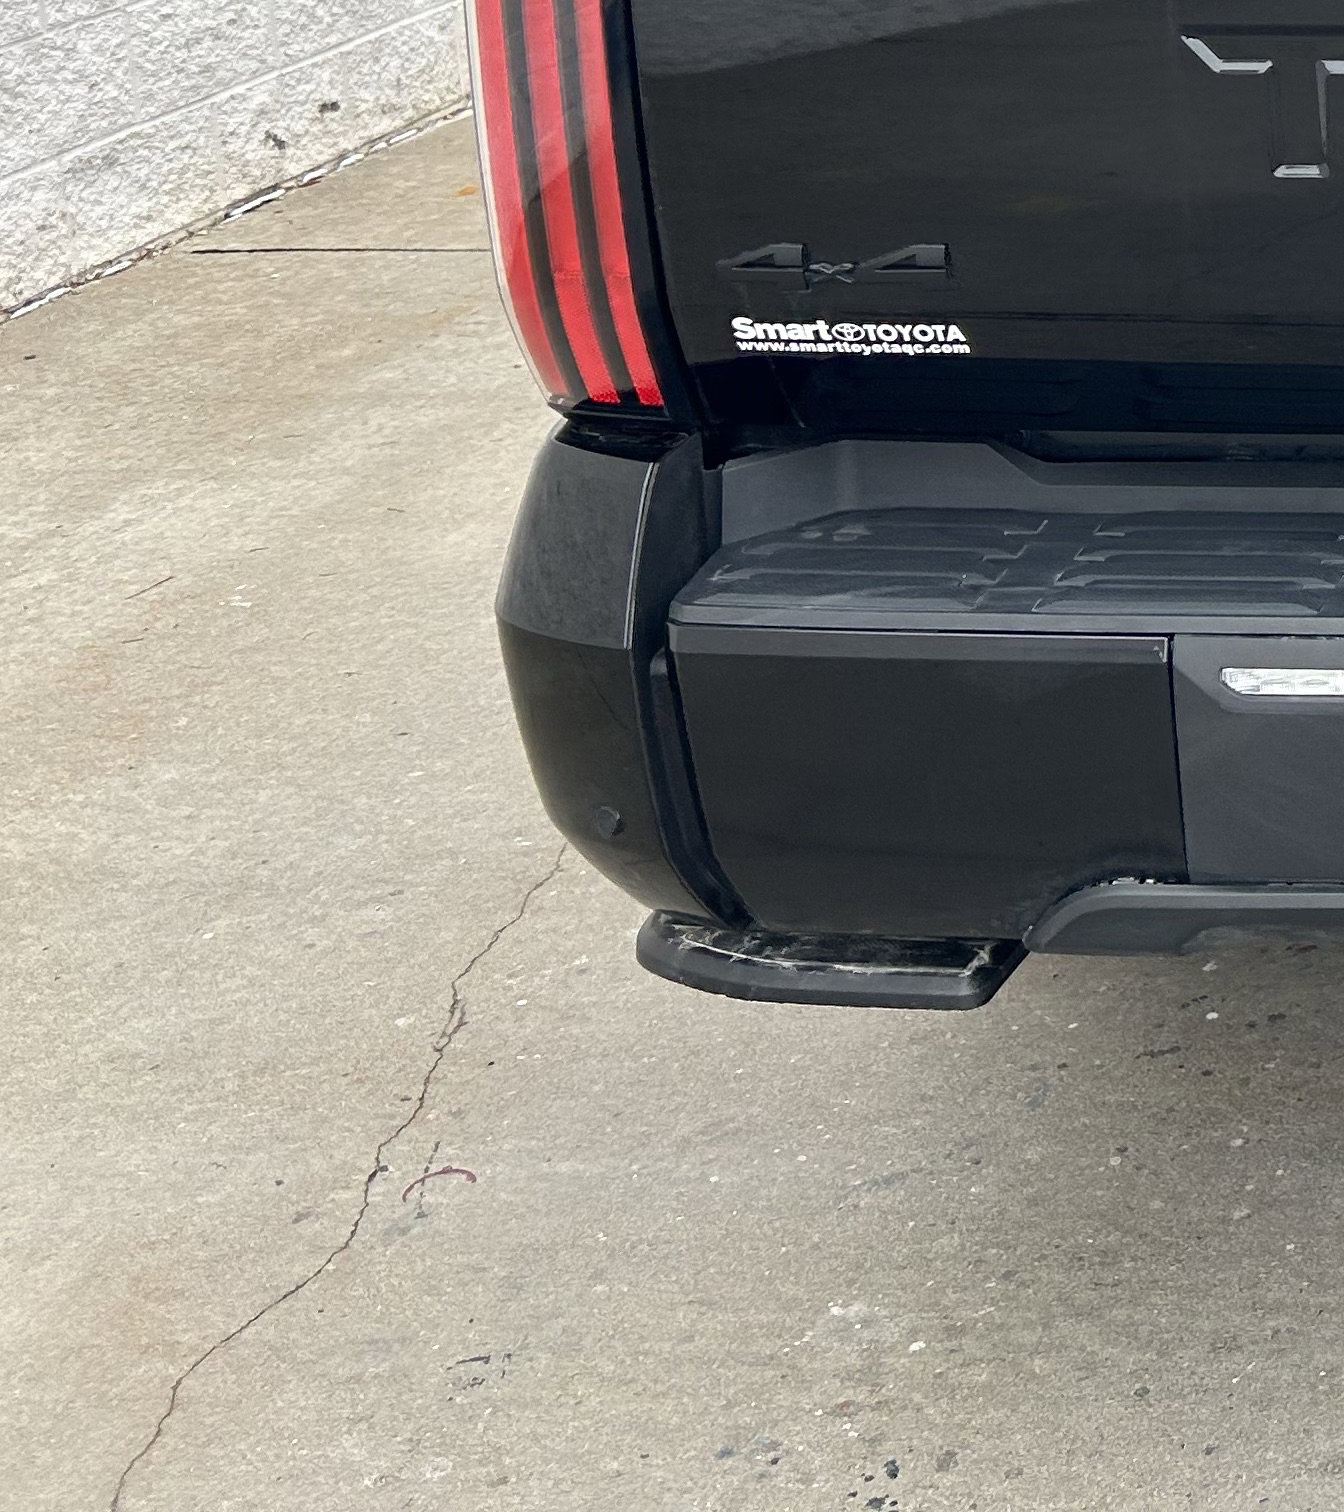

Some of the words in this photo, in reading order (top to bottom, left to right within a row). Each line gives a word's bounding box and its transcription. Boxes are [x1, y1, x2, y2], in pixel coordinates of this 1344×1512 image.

[731, 317, 834, 341] Smart
[863, 324, 968, 342] TOYOTA
[737, 340, 971, 355] www.smarttoyotaqc.com
